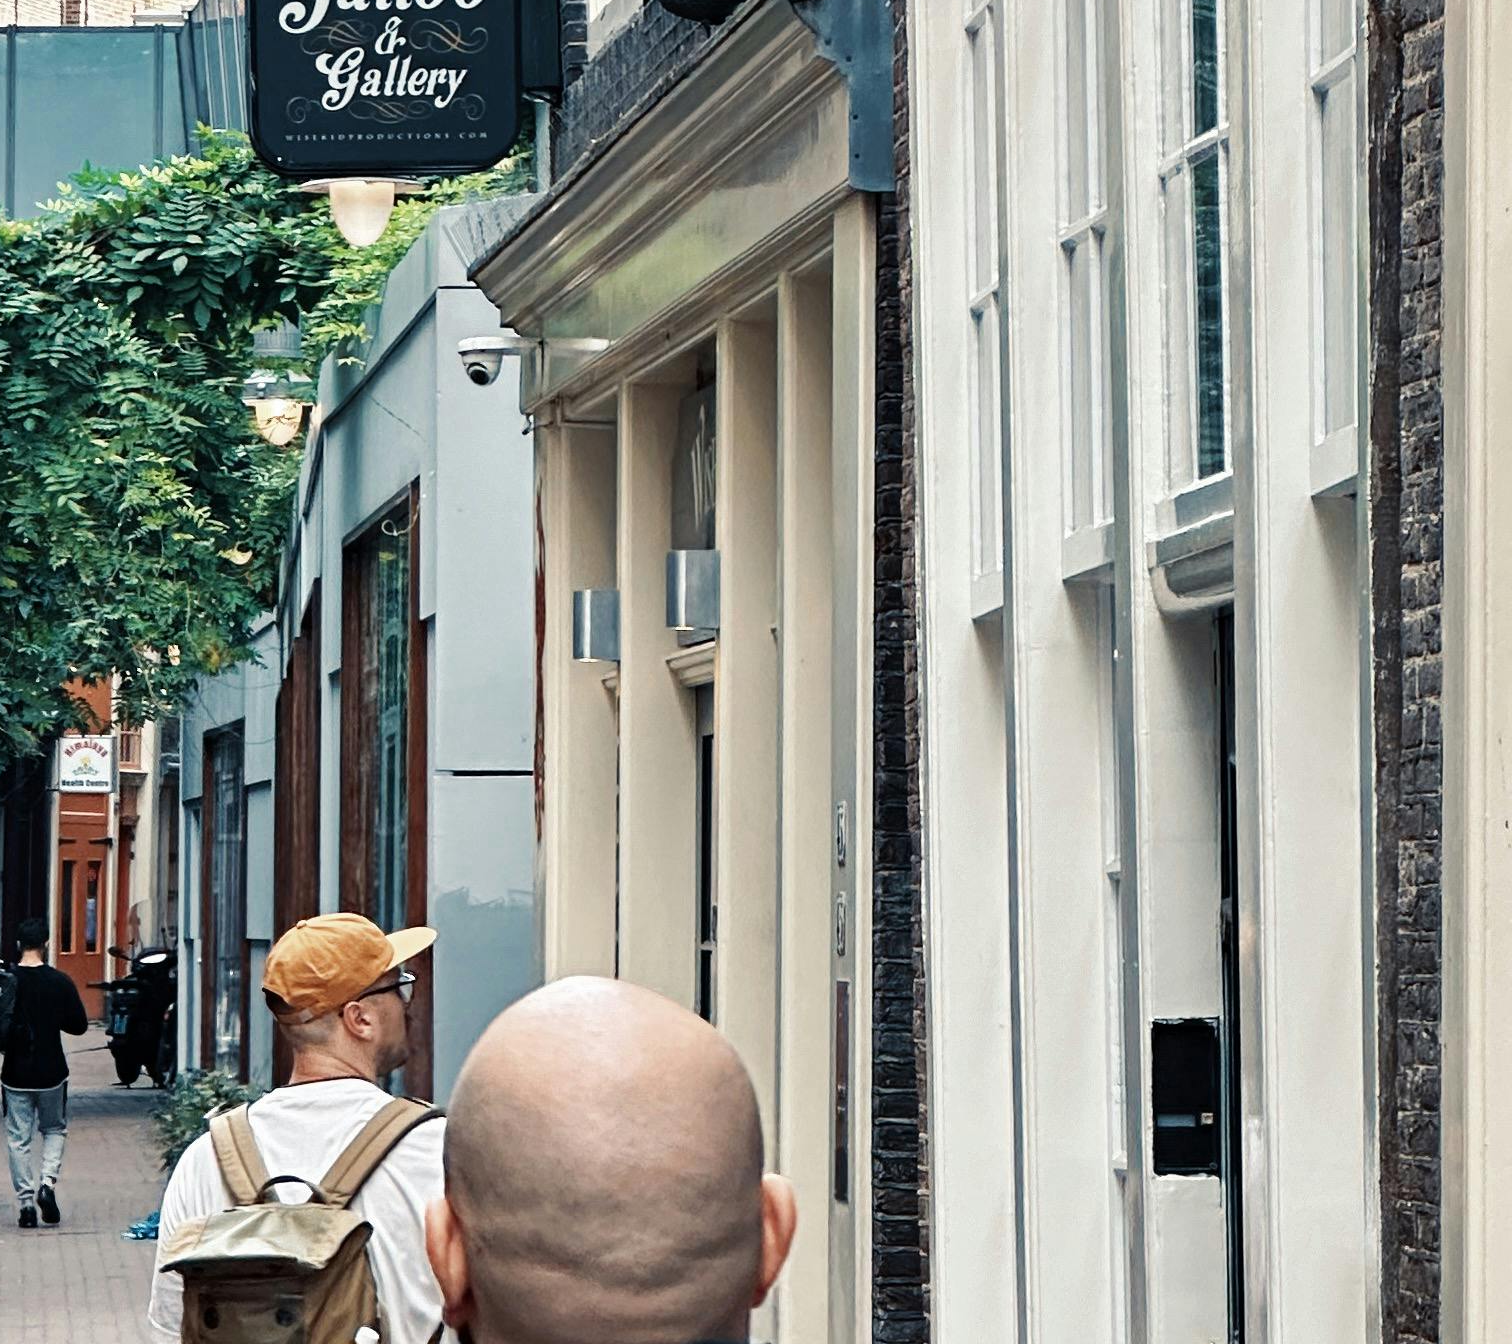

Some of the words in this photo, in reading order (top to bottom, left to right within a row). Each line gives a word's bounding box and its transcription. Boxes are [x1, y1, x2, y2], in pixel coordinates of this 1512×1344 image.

[374, 16, 407, 55] &
[315, 46, 468, 111] Gallery
[64, 741, 108, 757] Himalaya
